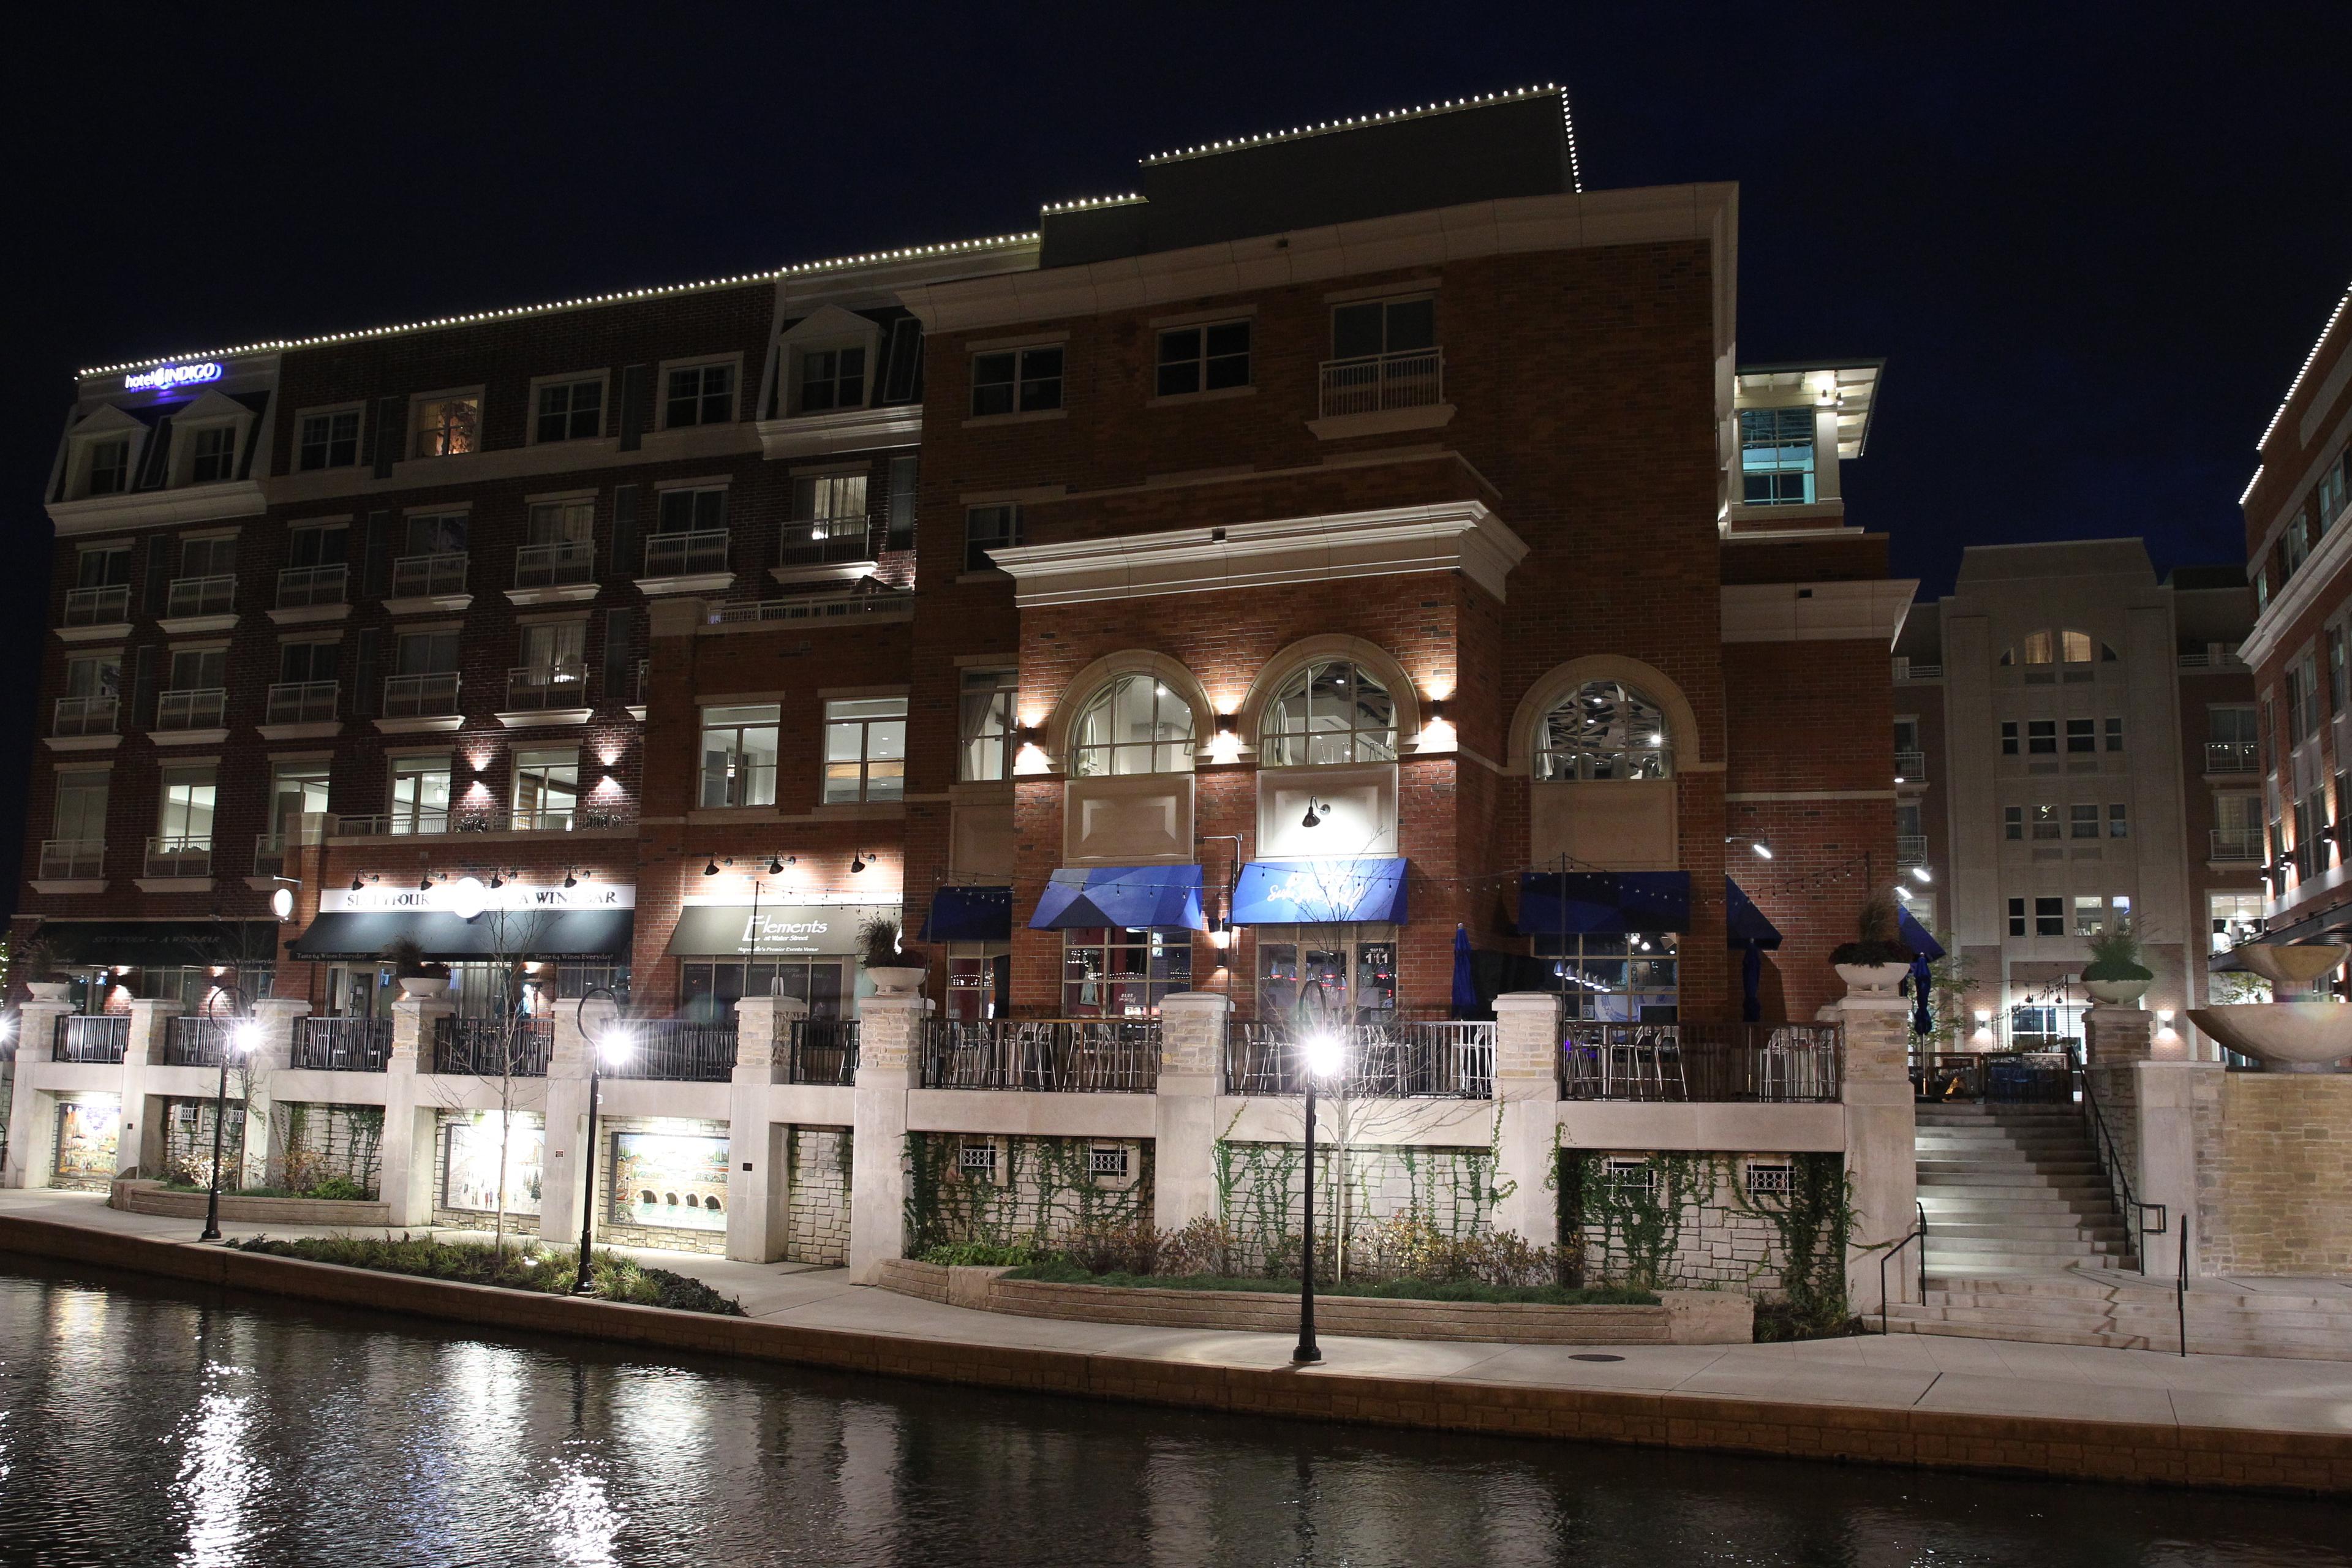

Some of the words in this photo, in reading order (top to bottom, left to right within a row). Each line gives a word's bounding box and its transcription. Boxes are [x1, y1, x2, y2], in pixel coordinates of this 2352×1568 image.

[125, 371, 154, 388] hotel
[164, 363, 216, 383] INDIGO
[347, 894, 430, 906] SITYFOUR
[519, 892, 529, 904] A
[535, 892, 578, 904] WINE
[742, 914, 828, 941] Elements
[338, 952, 368, 961] Everyday!
[1365, 953, 1388, 964] 111
